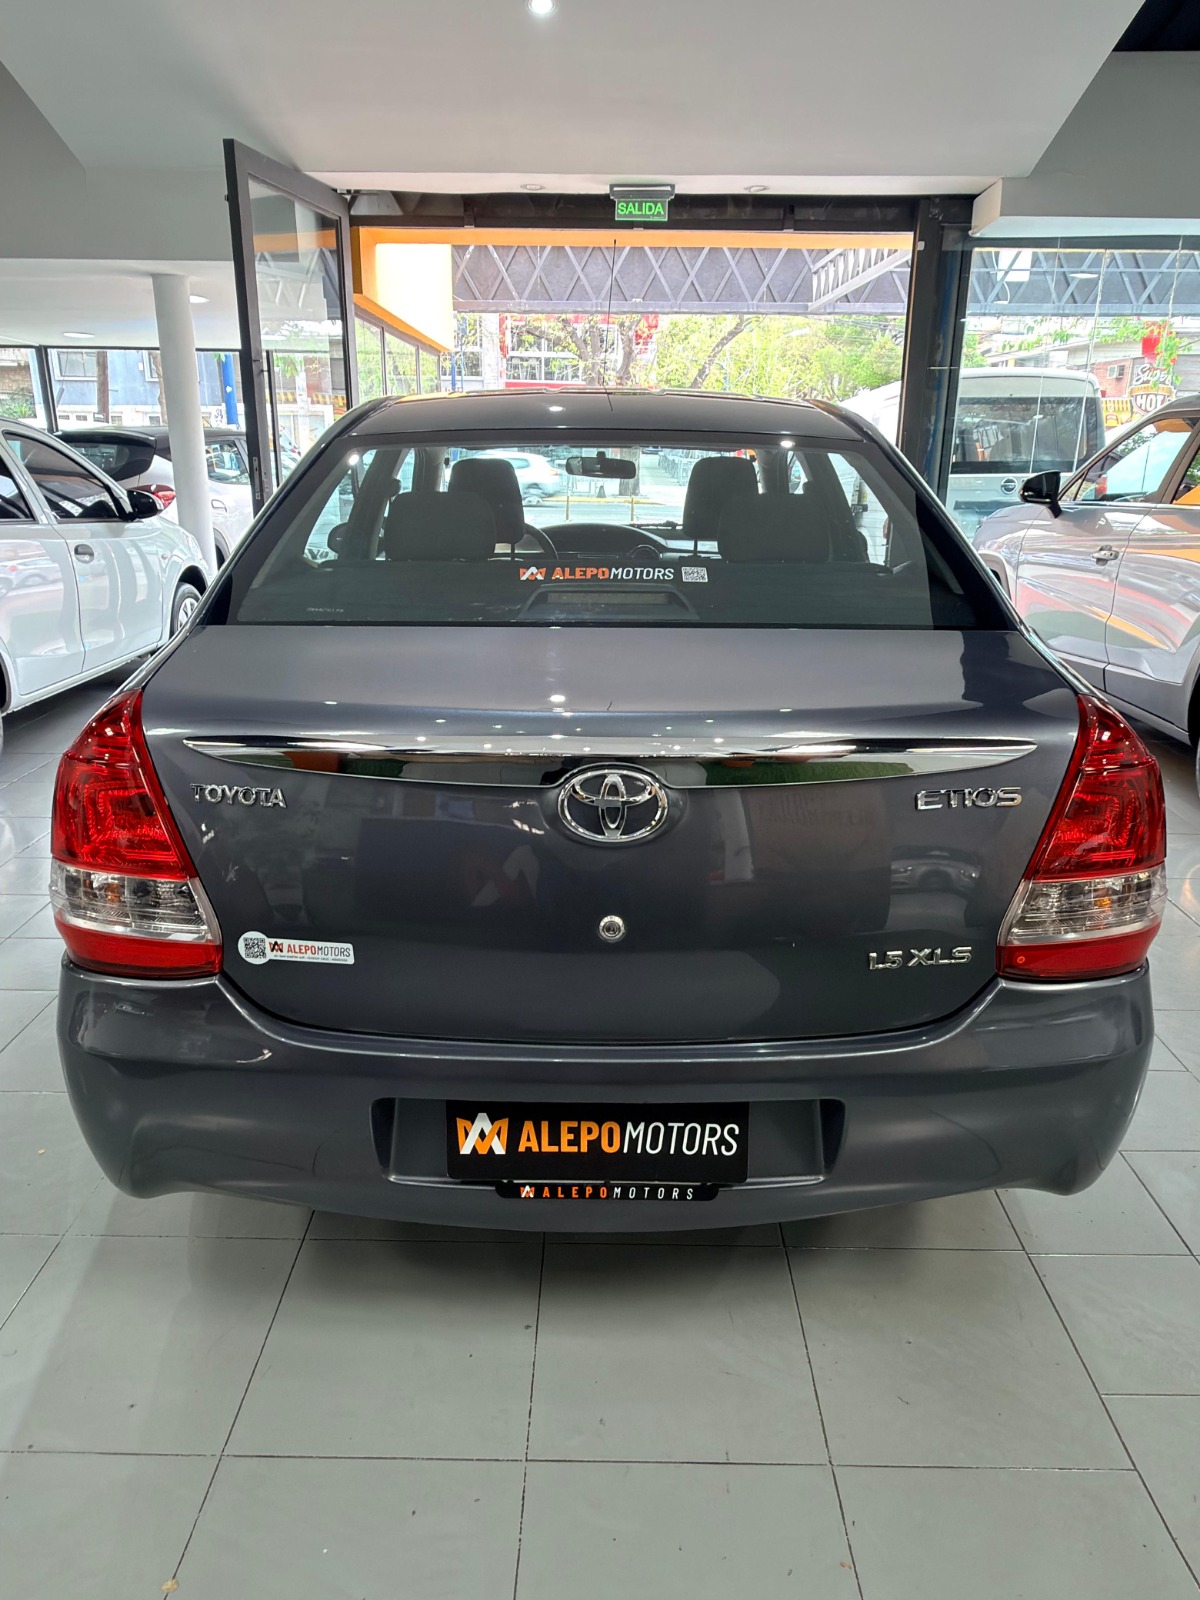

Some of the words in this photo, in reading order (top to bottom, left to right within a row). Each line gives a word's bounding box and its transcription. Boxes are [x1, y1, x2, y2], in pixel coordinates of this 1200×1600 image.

[618, 202, 664, 215] SALIDA
[551, 567, 675, 580] ALEPOMOTORS
[190, 783, 287, 808] TOYOTA
[915, 786, 1022, 810] ETIOS
[287, 943, 351, 958] ALEPOMOTORS
[907, 946, 972, 967] XLS
[518, 1120, 740, 1156] ALEPOMOTORS
